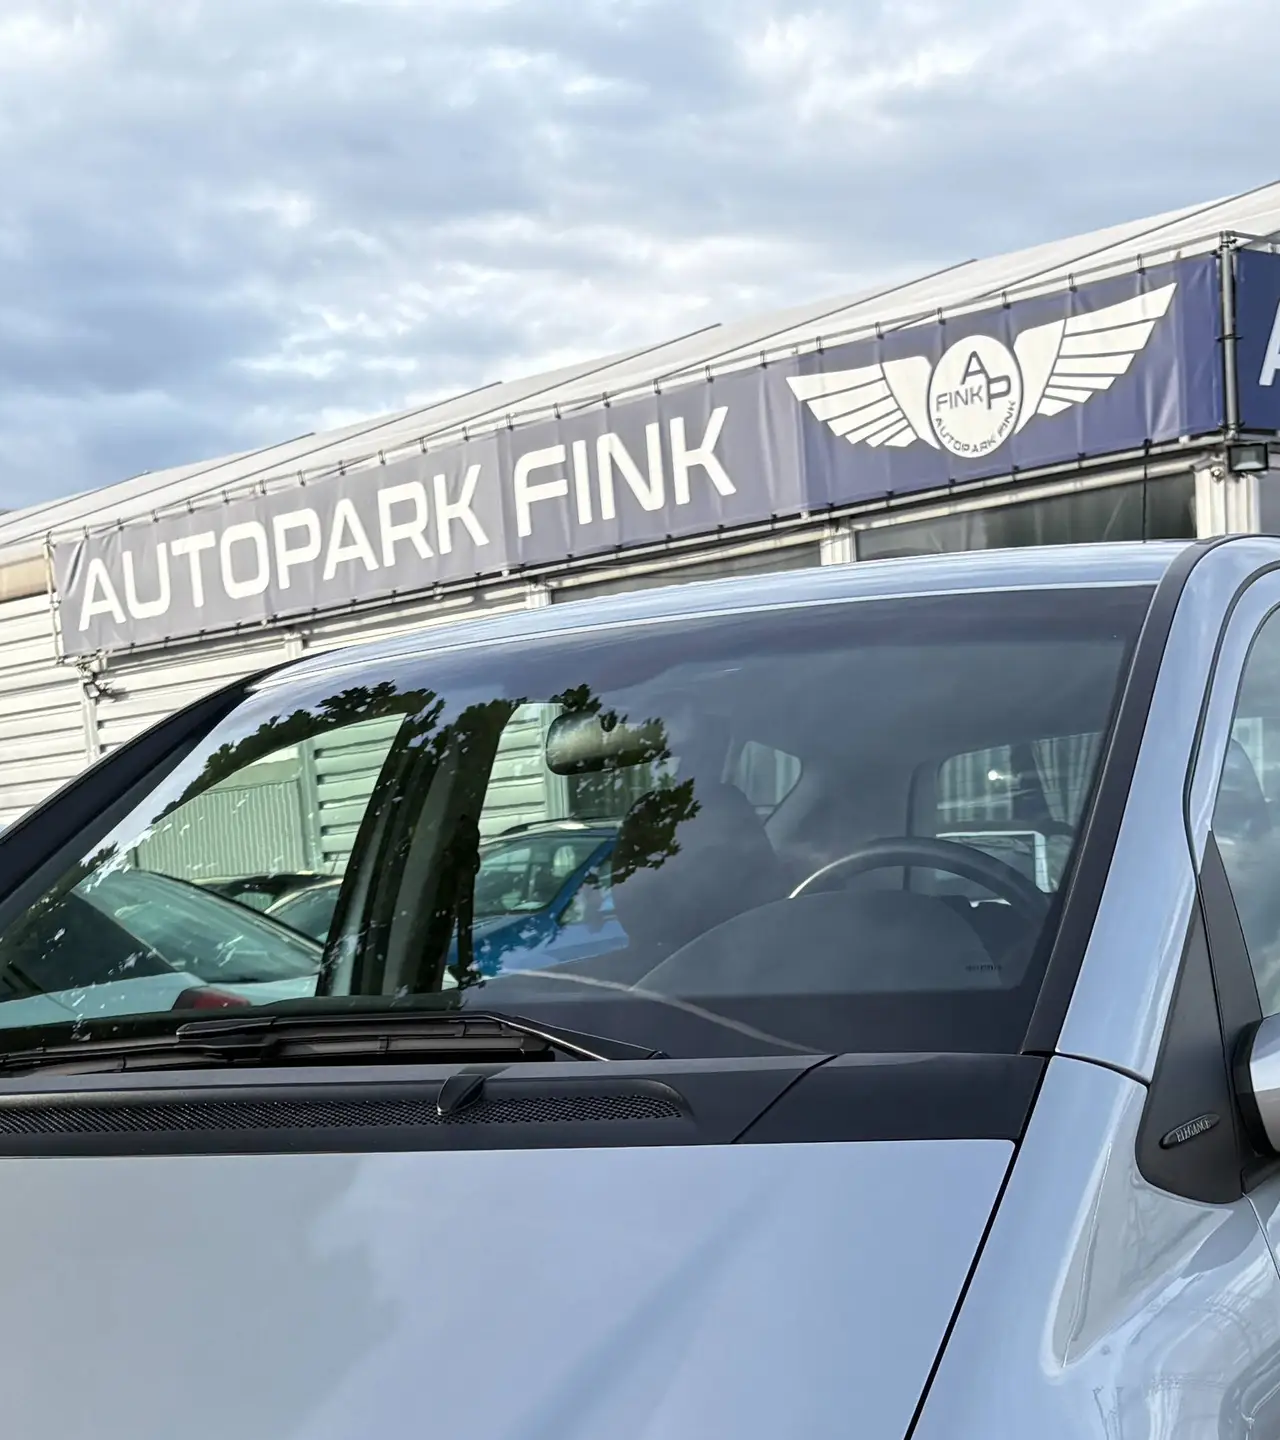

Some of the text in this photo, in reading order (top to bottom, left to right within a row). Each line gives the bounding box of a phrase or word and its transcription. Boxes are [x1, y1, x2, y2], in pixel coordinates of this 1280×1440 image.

[936, 384, 984, 412] FINK
[935, 400, 1016, 454] AUTOPARK FINK
[78, 406, 736, 631] AUTOPARK FINK
[1175, 1118, 1212, 1143] ELEGANCE
